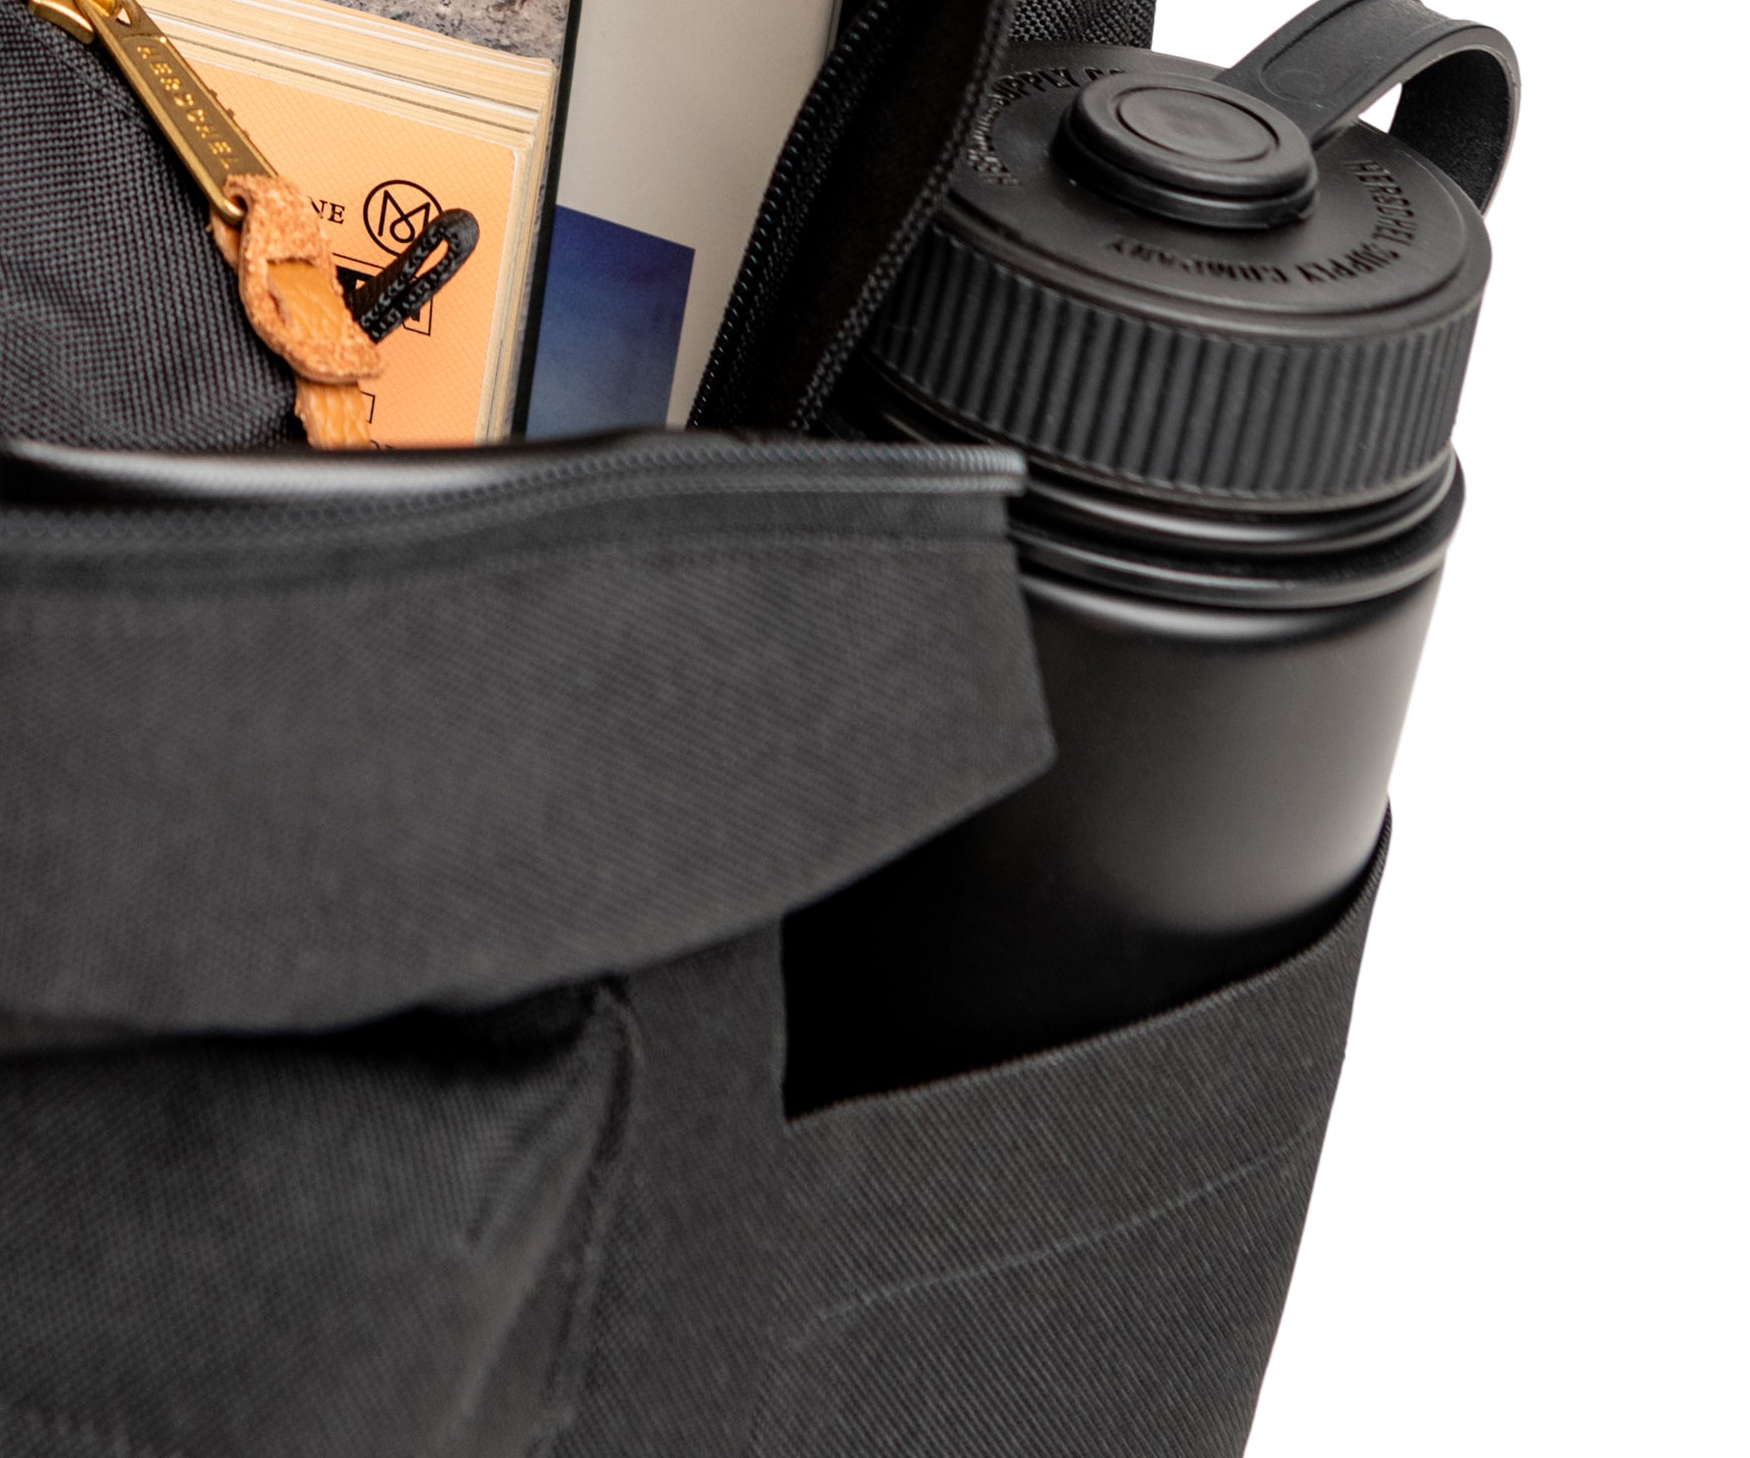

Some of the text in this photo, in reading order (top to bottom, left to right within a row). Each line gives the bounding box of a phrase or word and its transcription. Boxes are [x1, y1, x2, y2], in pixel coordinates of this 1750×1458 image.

[136, 45, 240, 170] HERSCHEL
[1105, 158, 1418, 286] HERSCHEL SUPPLY COMPANY
